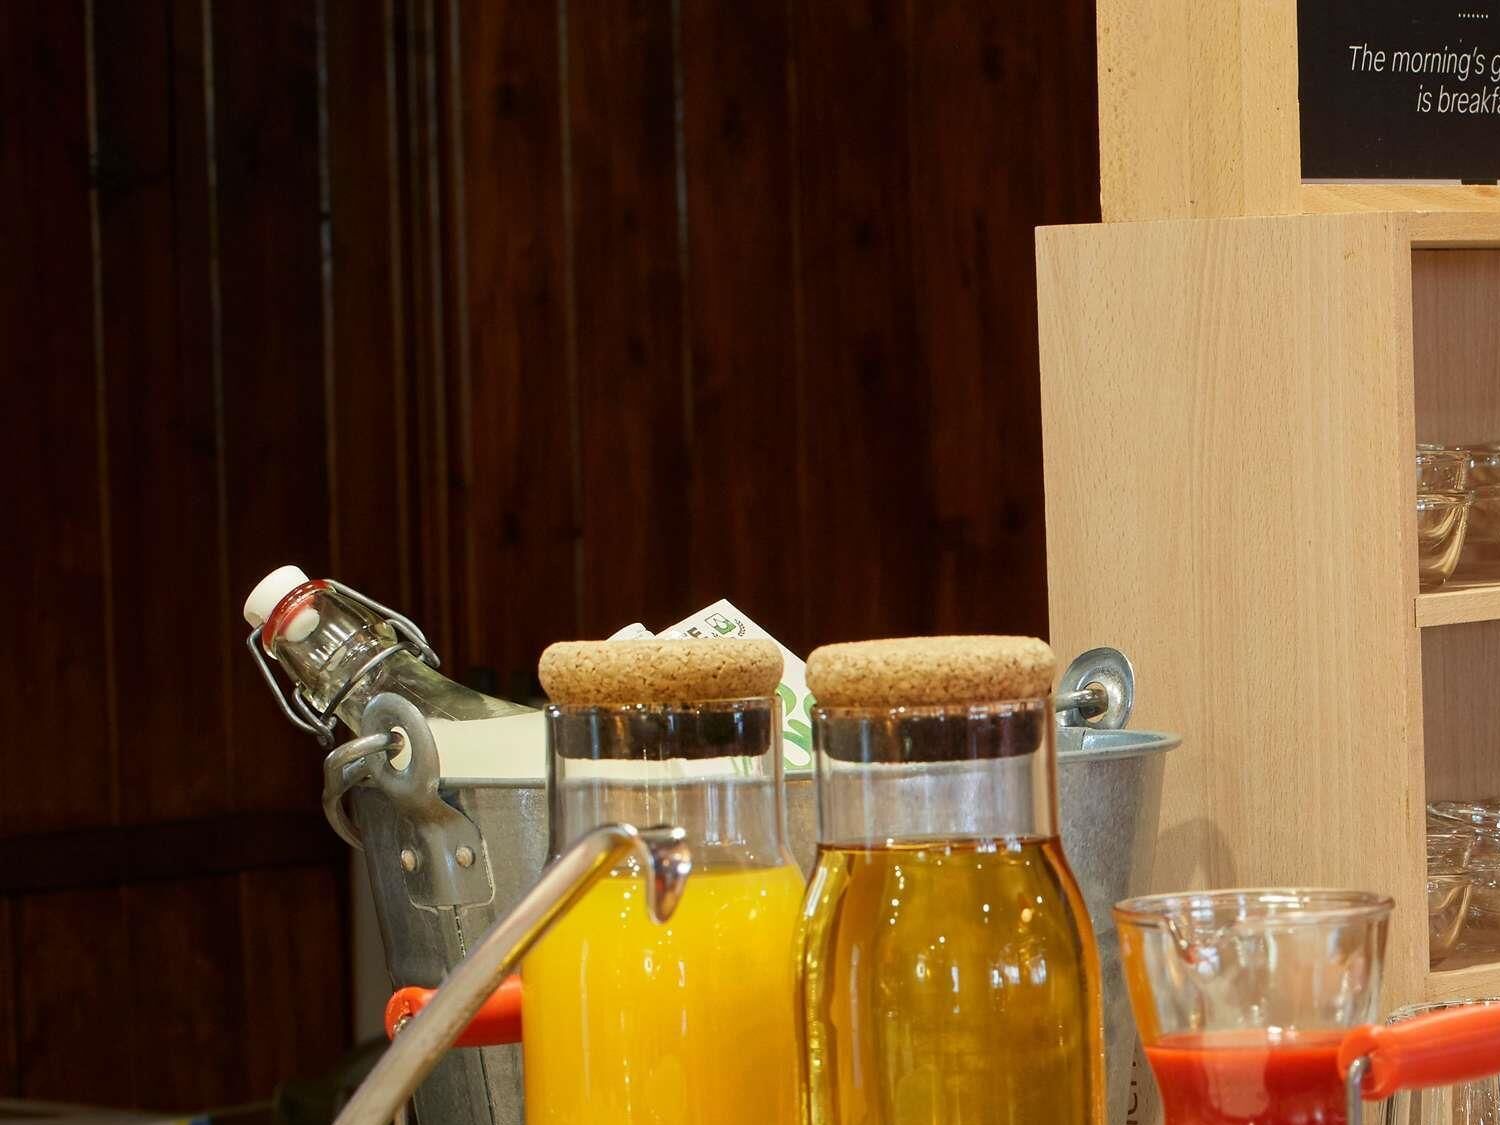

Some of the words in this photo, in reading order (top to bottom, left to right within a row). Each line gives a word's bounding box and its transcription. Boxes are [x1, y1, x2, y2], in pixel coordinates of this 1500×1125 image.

[1349, 45, 1385, 72] The
[1392, 46, 1485, 82] morning's
[1417, 84, 1433, 113] is
